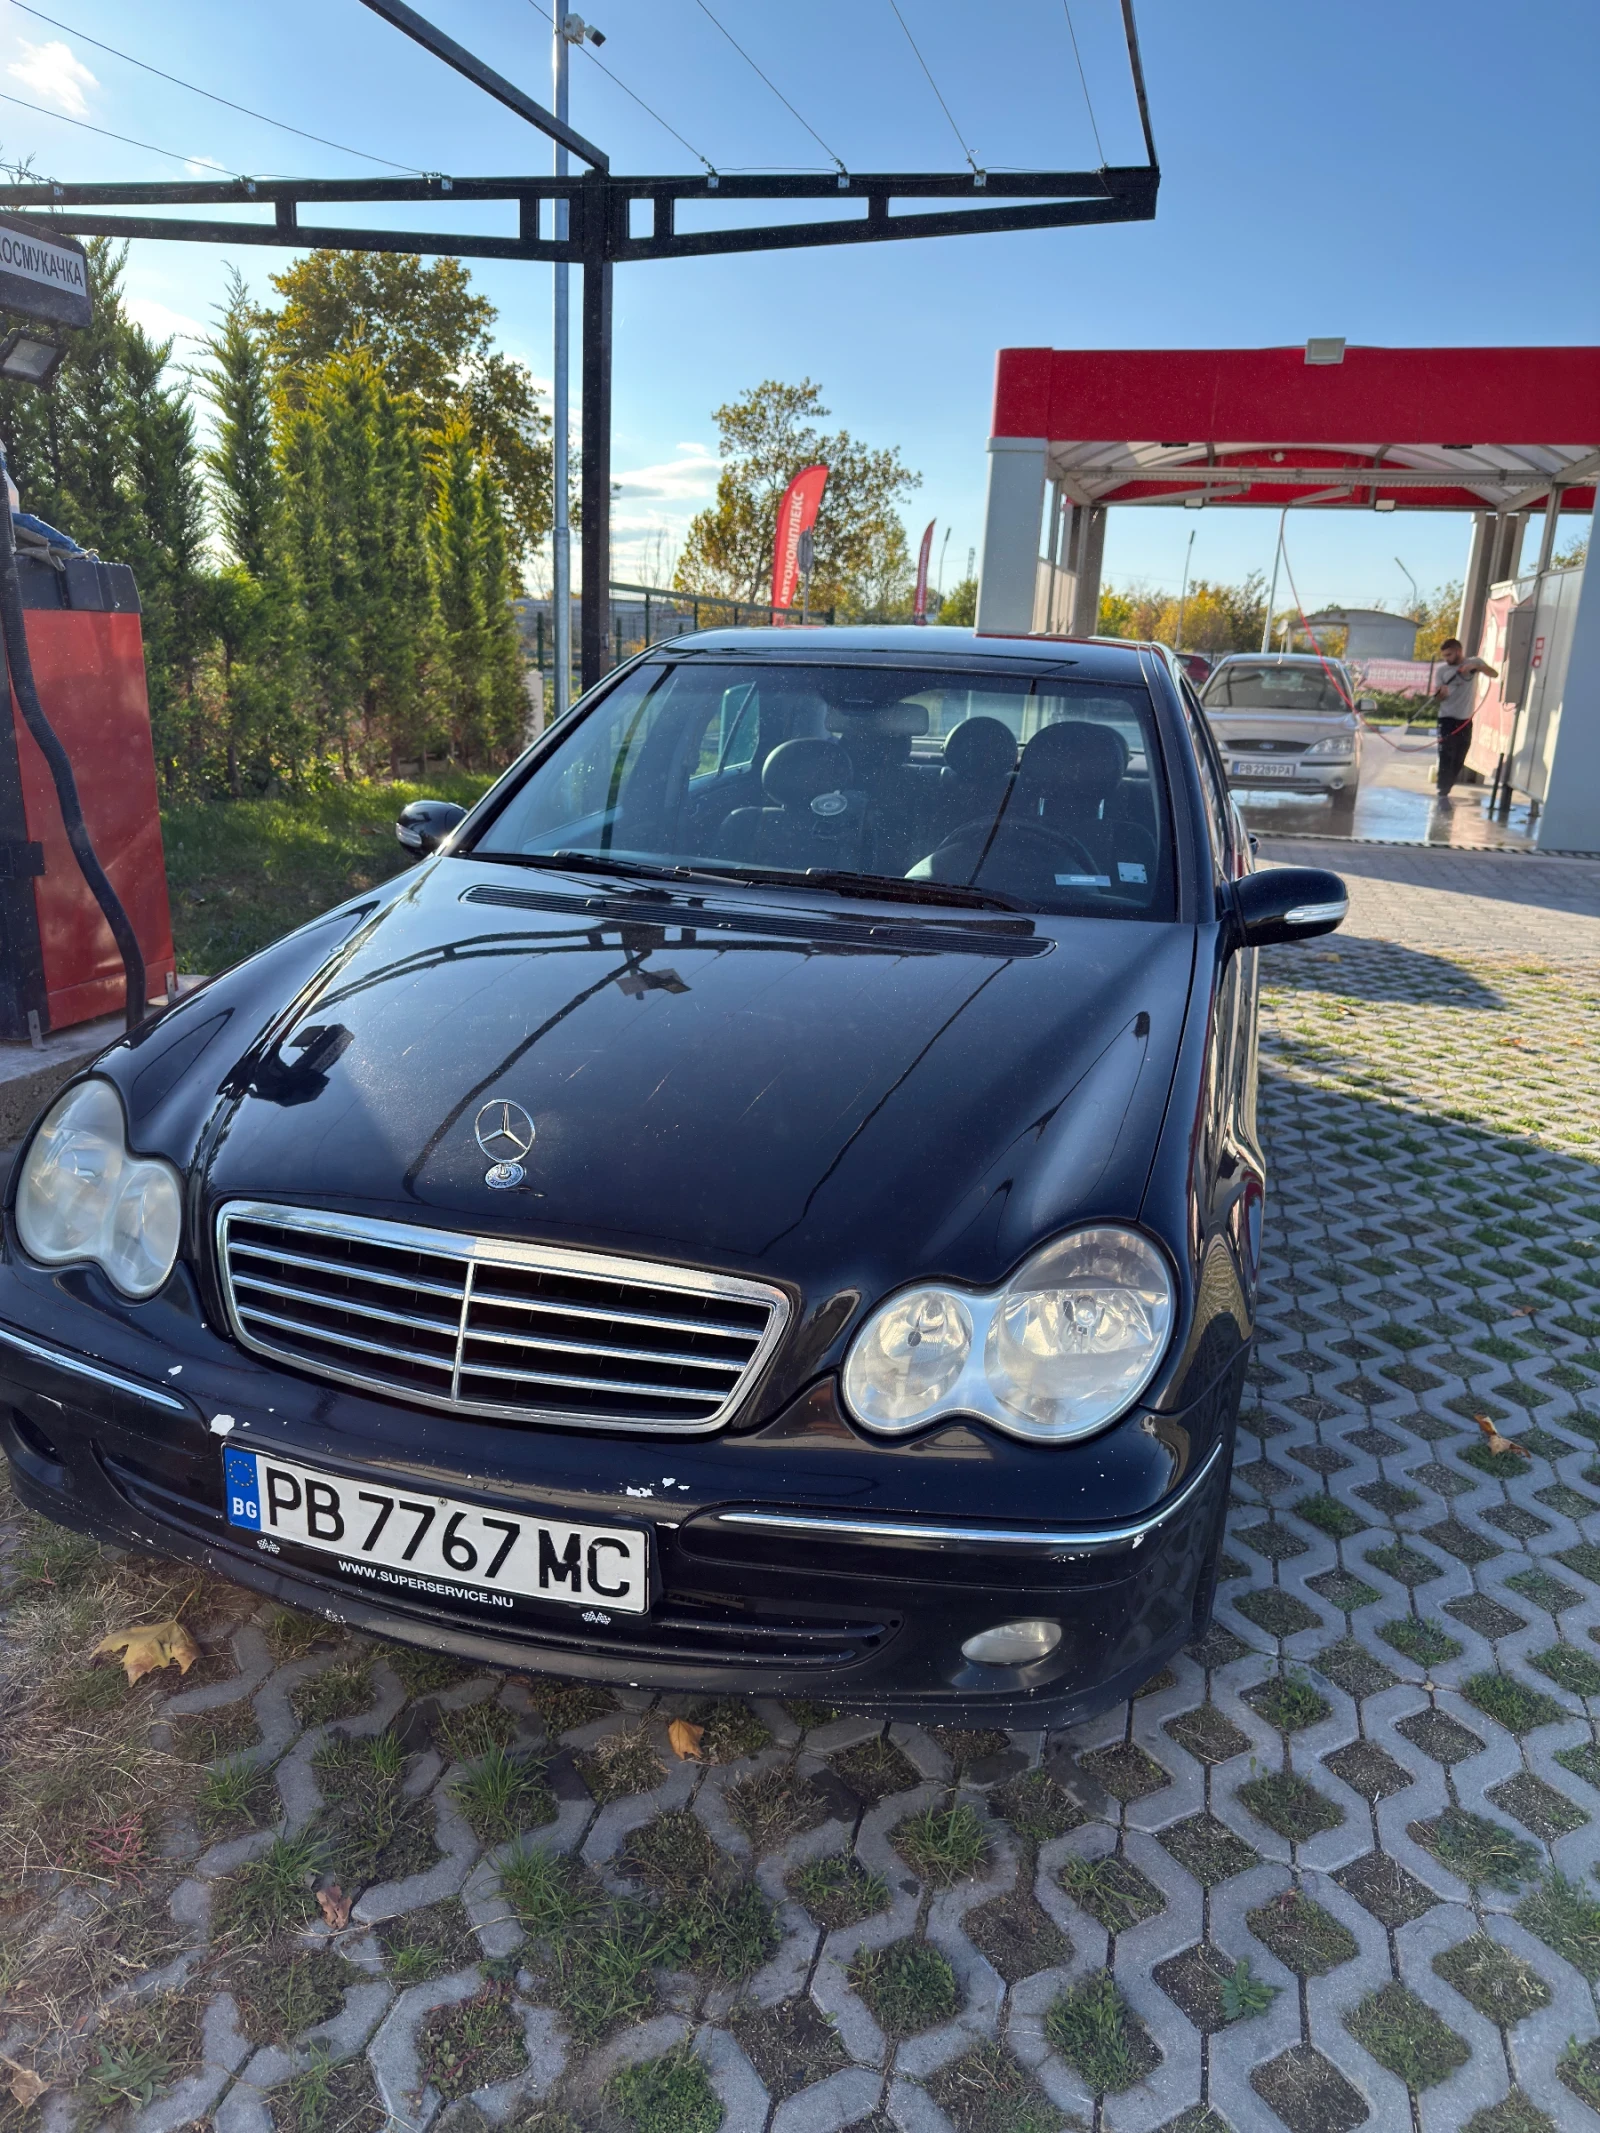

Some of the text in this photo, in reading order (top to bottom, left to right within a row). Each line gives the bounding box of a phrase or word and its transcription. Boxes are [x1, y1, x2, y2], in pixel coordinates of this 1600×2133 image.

[780, 490, 804, 605] АВТОКОМПЛЕКС
[232, 1497, 258, 1519] BG
[338, 1560, 514, 1608] WWW.SUPERSERVICE.NU
